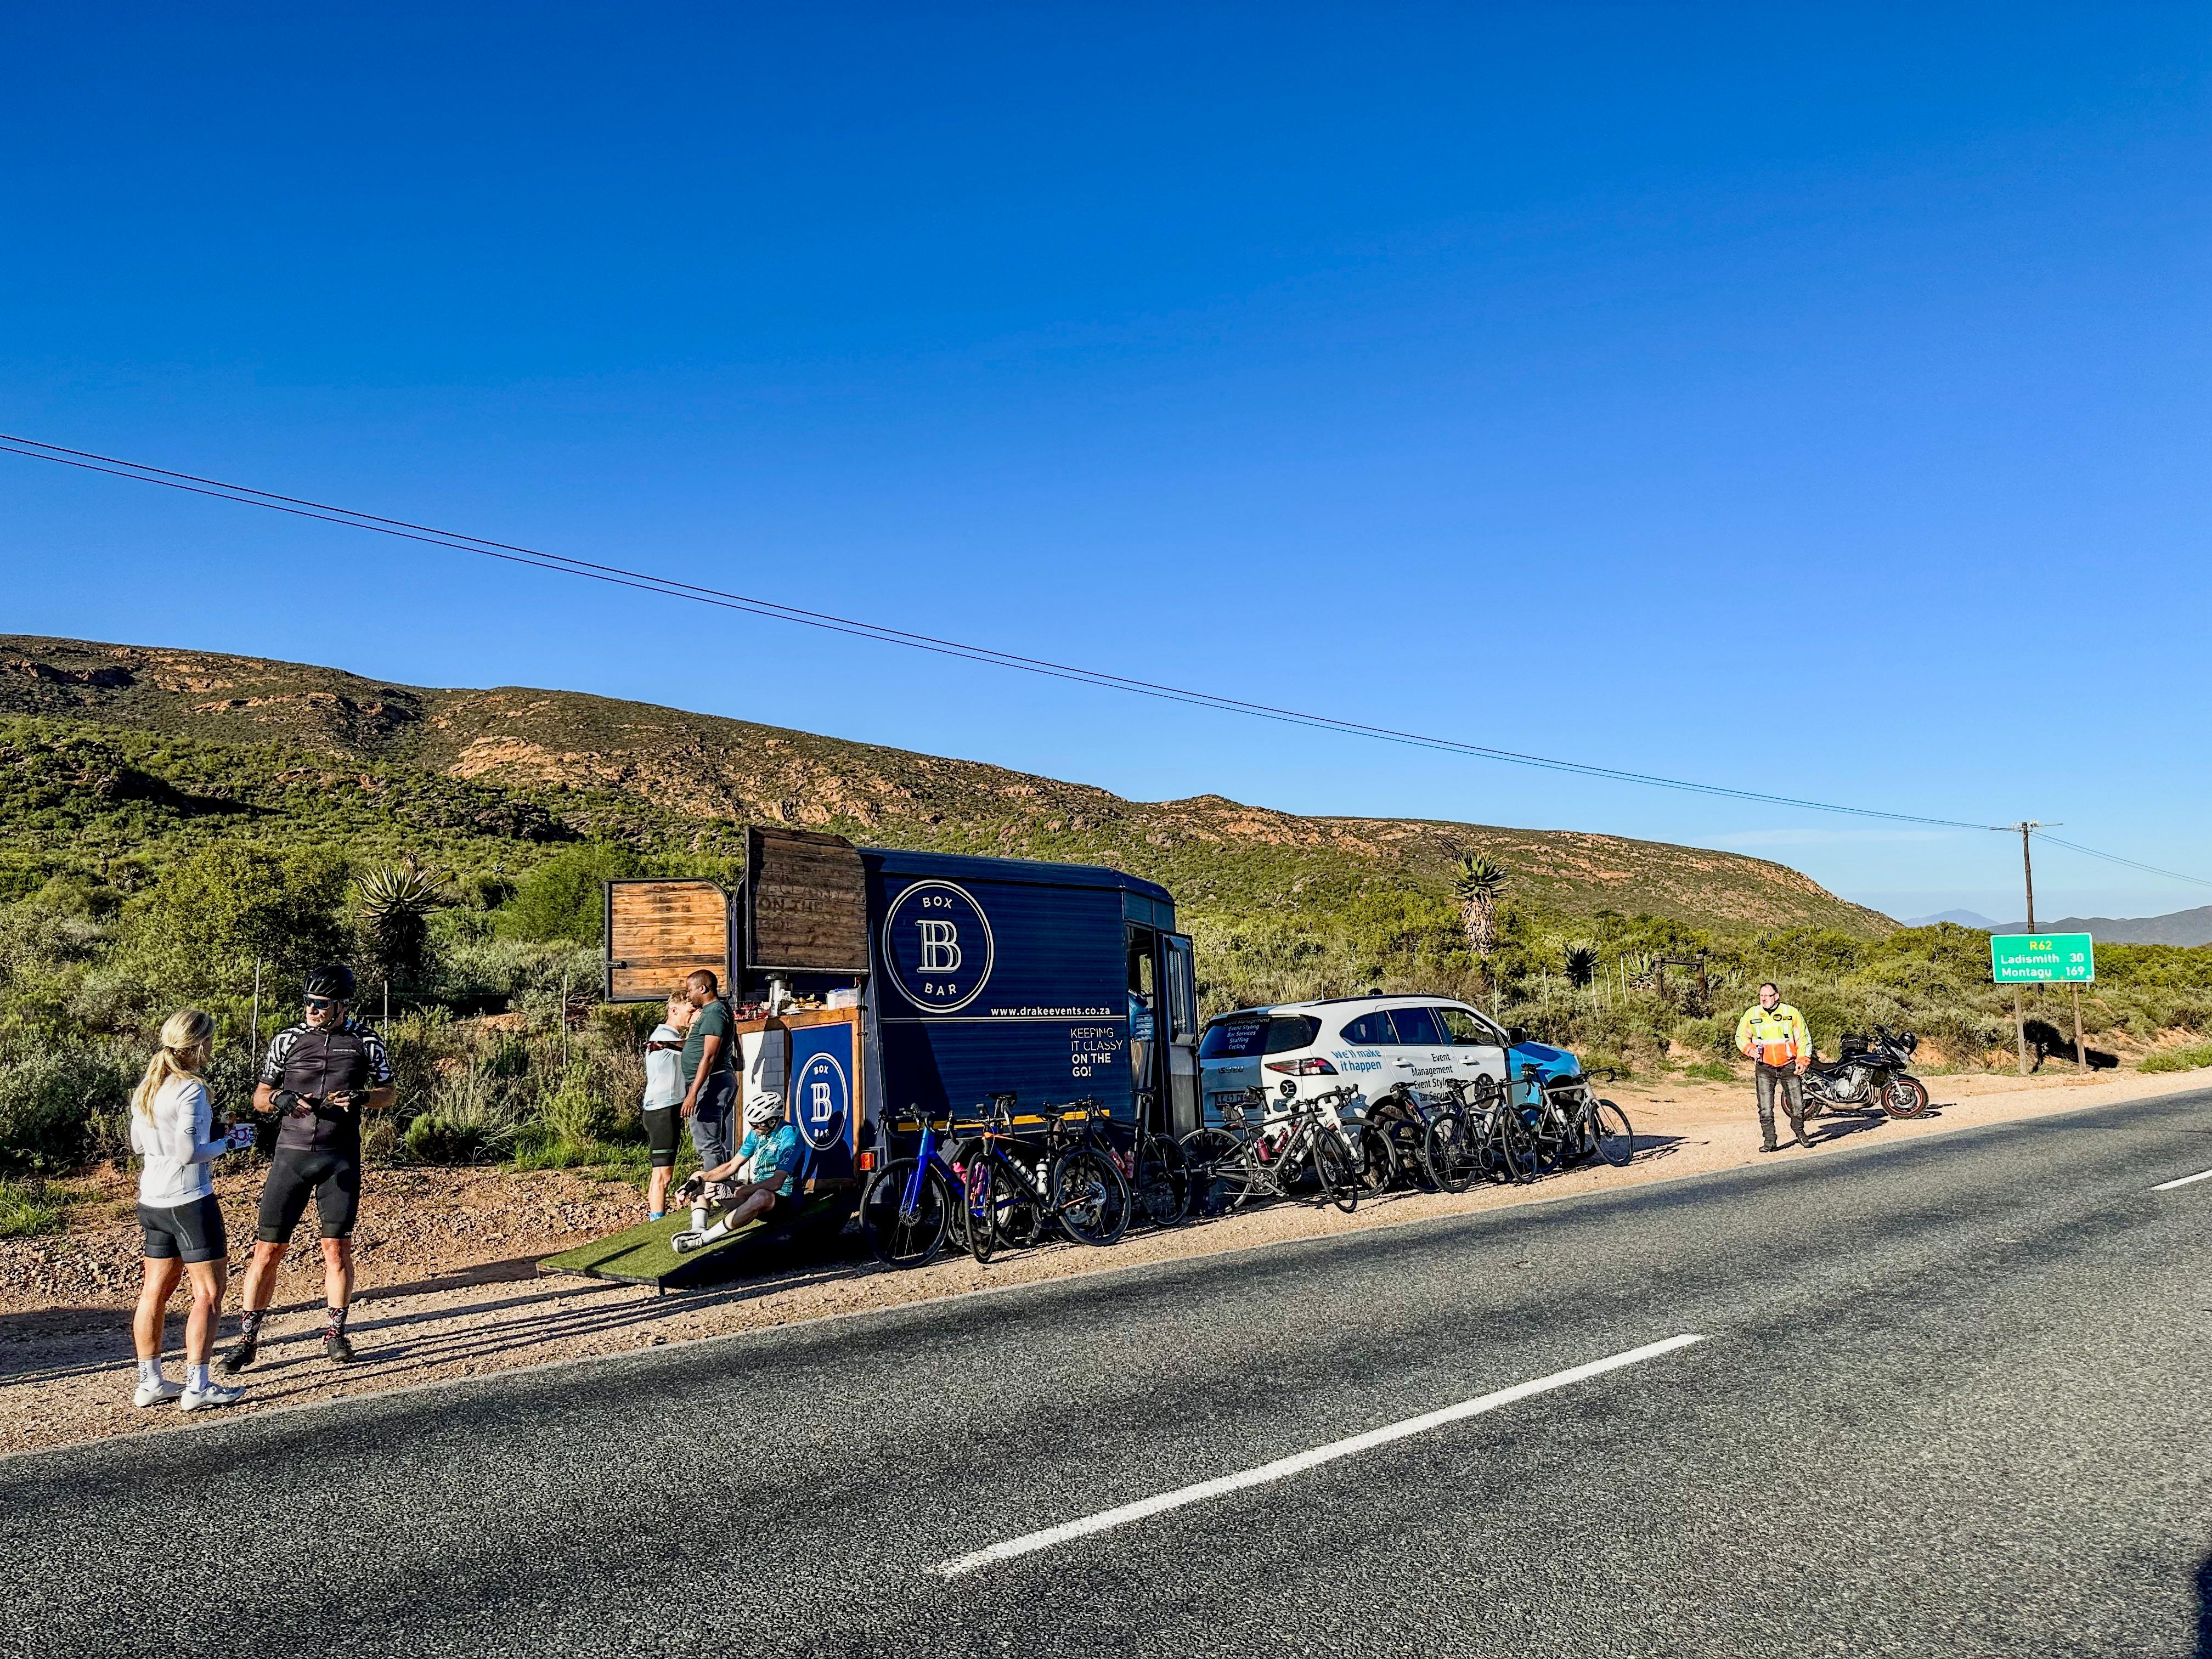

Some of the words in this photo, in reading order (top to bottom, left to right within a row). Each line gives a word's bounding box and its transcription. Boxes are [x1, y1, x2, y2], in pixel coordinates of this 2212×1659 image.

[923, 896, 952, 909] BOX
[2029, 940, 2052, 951] R62
[2001, 953, 2060, 964] Ladismith
[2069, 952, 2084, 963] 30
[2001, 967, 2052, 979] Montagu
[2066, 966, 2085, 977] 169
[924, 983, 957, 995] BAR
[991, 1007, 1110, 1015] www.drakeevents.co.za
[1070, 1028, 1114, 1039] KEEPING
[1071, 1041, 1080, 1051] IT
[1084, 1040, 1123, 1051] CLASSY
[1072, 1053, 1087, 1064] ON
[1091, 1053, 1111, 1063] THE
[1331, 1049, 1356, 1058] We'll
[1356, 1049, 1381, 1058] make
[1431, 1053, 1451, 1062] Event
[814, 1065, 828, 1075] BOX
[1073, 1066, 1092, 1077] GO!
[1340, 1060, 1348, 1071] it
[1348, 1060, 1382, 1073] happen
[1411, 1065, 1453, 1077] Management
[1414, 1079, 1431, 1089] Event
[1432, 1077, 1451, 1088] Styli
[1419, 1092, 1428, 1102] Bar
[814, 1128, 830, 1138] BAR
